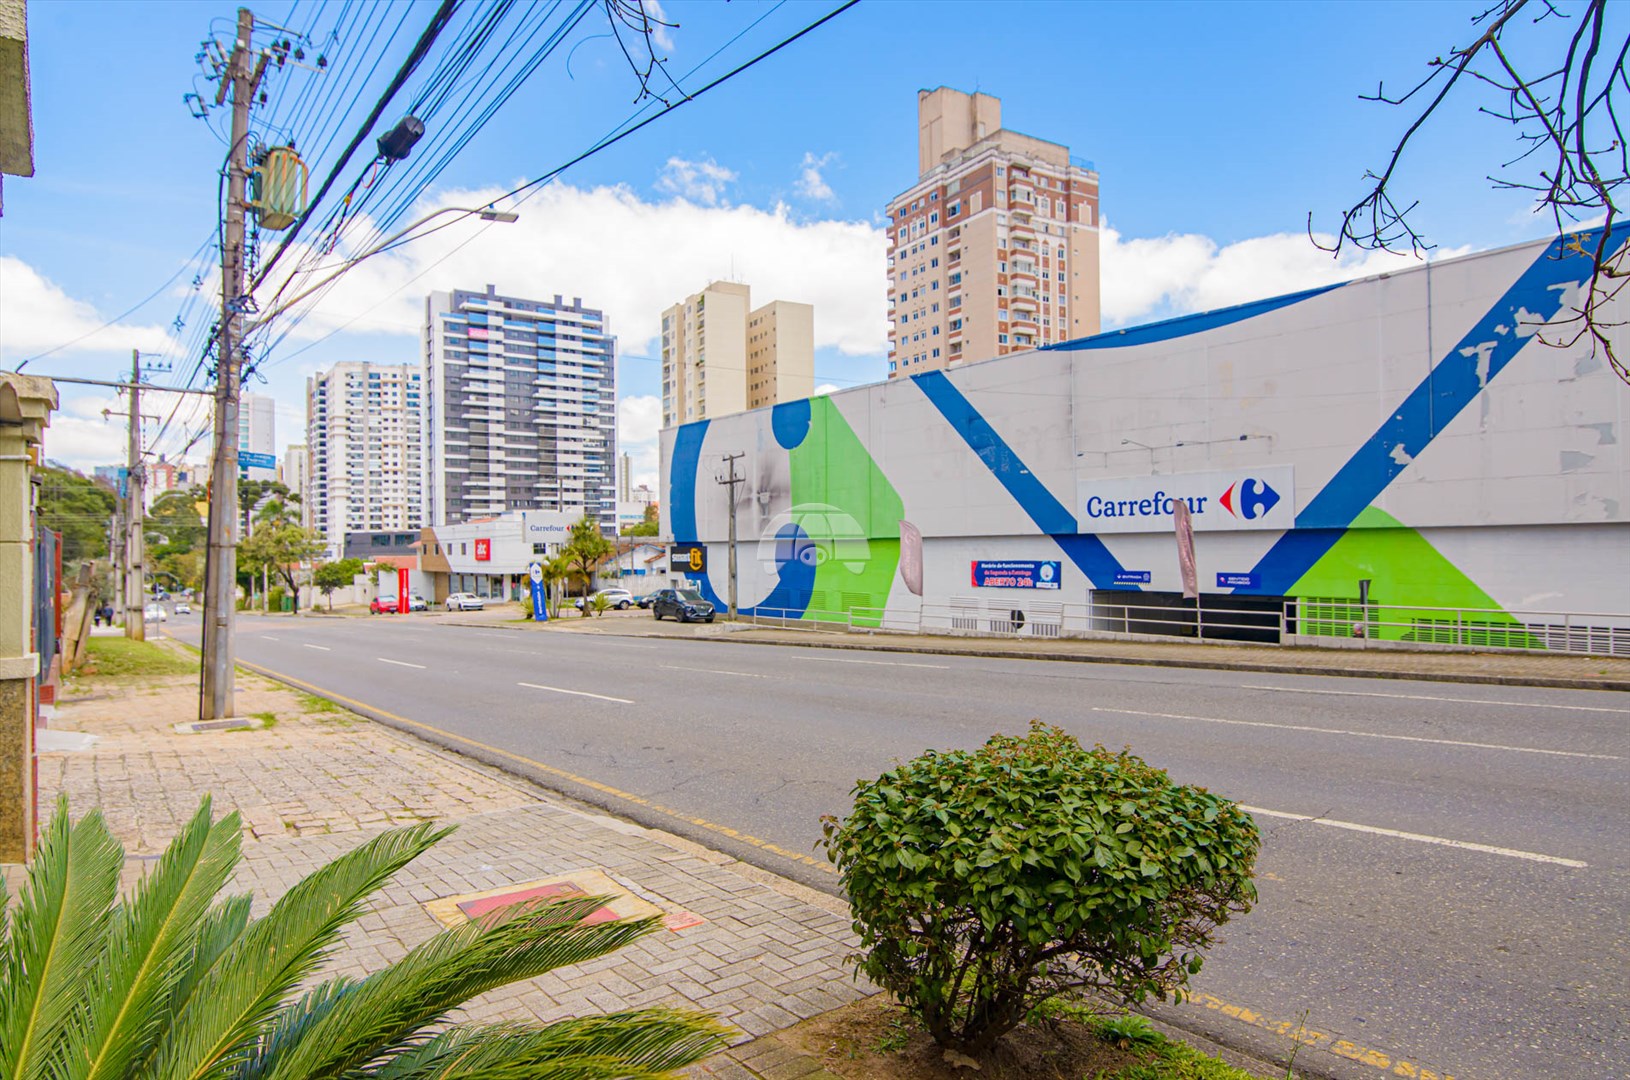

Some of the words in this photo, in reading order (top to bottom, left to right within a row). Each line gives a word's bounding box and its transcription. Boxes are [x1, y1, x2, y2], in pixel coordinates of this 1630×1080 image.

[1086, 491, 1208, 518] Carrefour
[984, 577, 1016, 587] ABERTO
[1017, 577, 1033, 587] 24h
